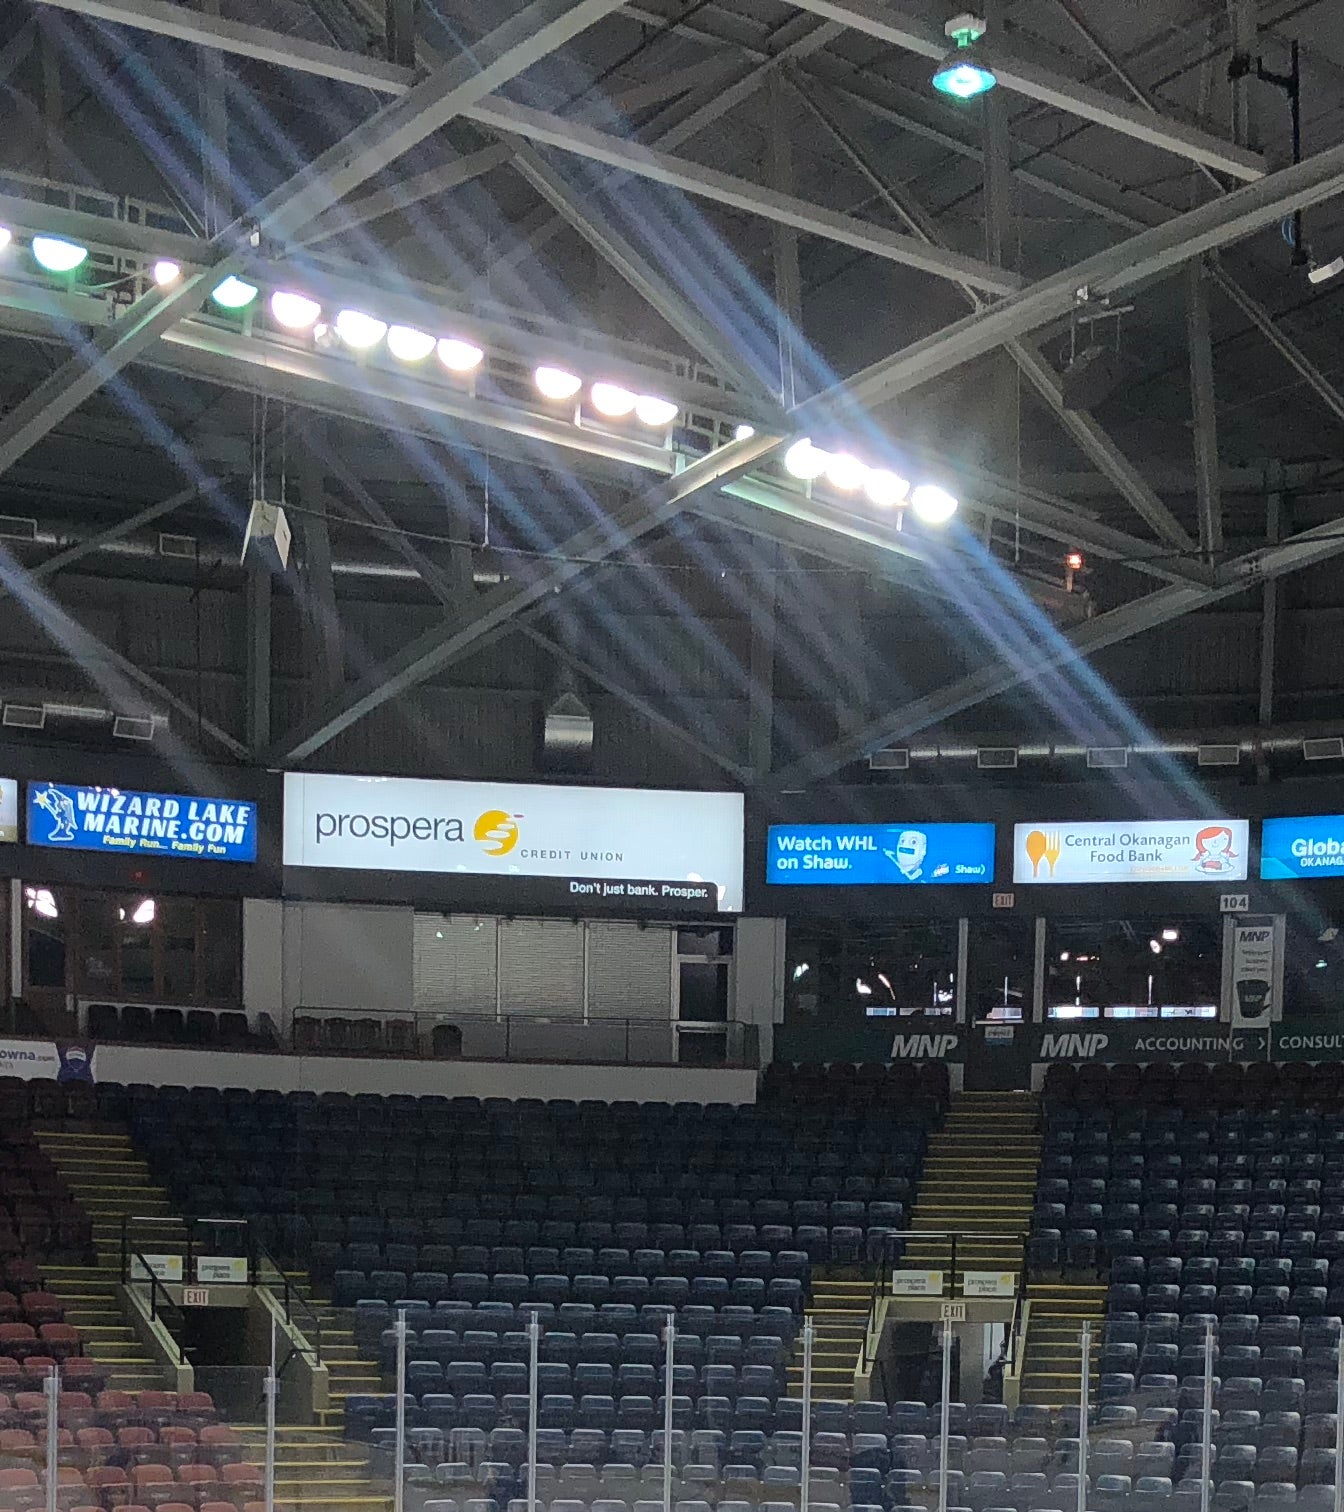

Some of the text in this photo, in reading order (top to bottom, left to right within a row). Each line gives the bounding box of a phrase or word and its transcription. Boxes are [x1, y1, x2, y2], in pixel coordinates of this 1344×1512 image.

[78, 790, 250, 826] WIZARD LAKE
[83, 814, 245, 845] MARINE.COM
[315, 811, 465, 847] prospera
[777, 834, 877, 852] Watch WHL
[1065, 833, 1191, 853] Central Okanagan
[520, 848, 624, 862] CREDIT UNION
[777, 854, 853, 871] on Shaw.
[1090, 848, 1163, 864] Food Bank
[570, 881, 708, 901] Don't just bank. Prosper.
[1222, 896, 1247, 909] 104
[1240, 931, 1270, 942] MNP
[891, 1034, 958, 1058] MNP
[1041, 1034, 1108, 1057] MNP
[1134, 1036, 1244, 1051] ACCOUNTING
[187, 1291, 207, 1304] EXIT
[944, 1305, 964, 1318] EXIT
